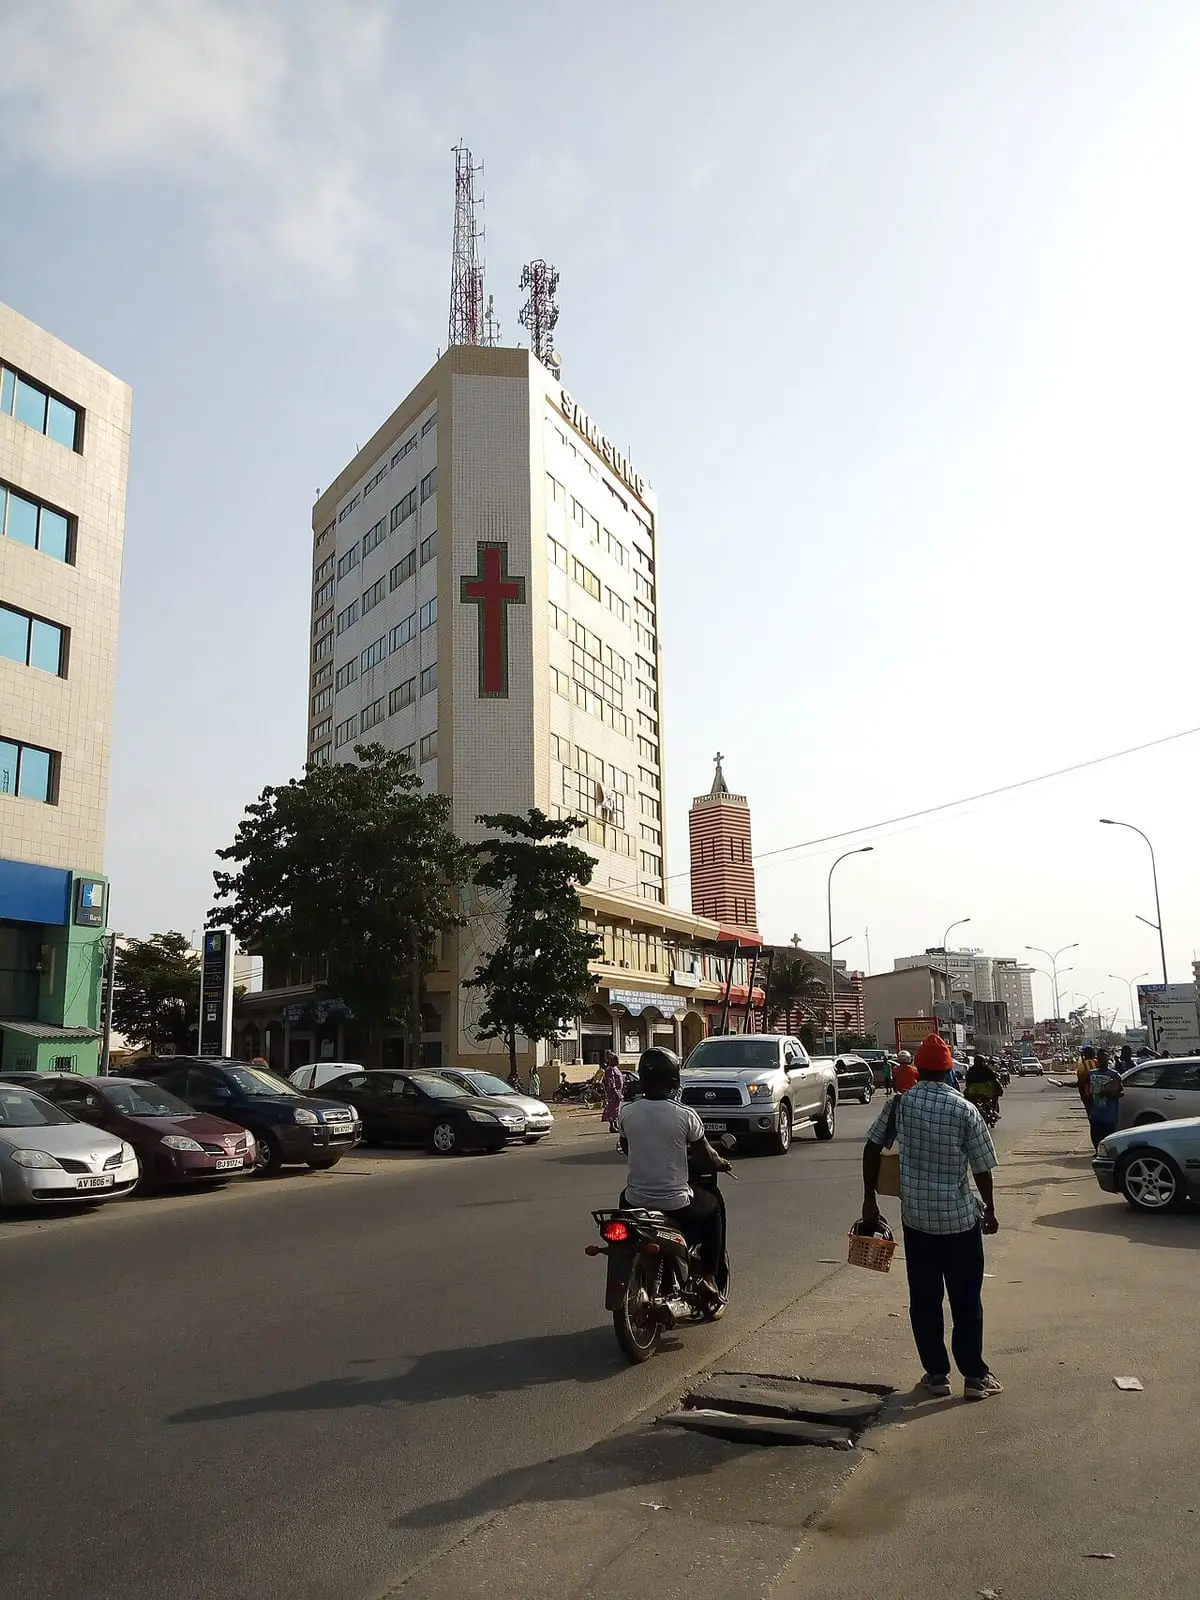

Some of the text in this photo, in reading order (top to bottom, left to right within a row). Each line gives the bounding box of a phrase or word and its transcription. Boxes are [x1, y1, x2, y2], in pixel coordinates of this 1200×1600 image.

[560, 389, 645, 499] SAMSUNG
[77, 1180, 89, 1188] AV
[90, 1178, 105, 1187] 1606
